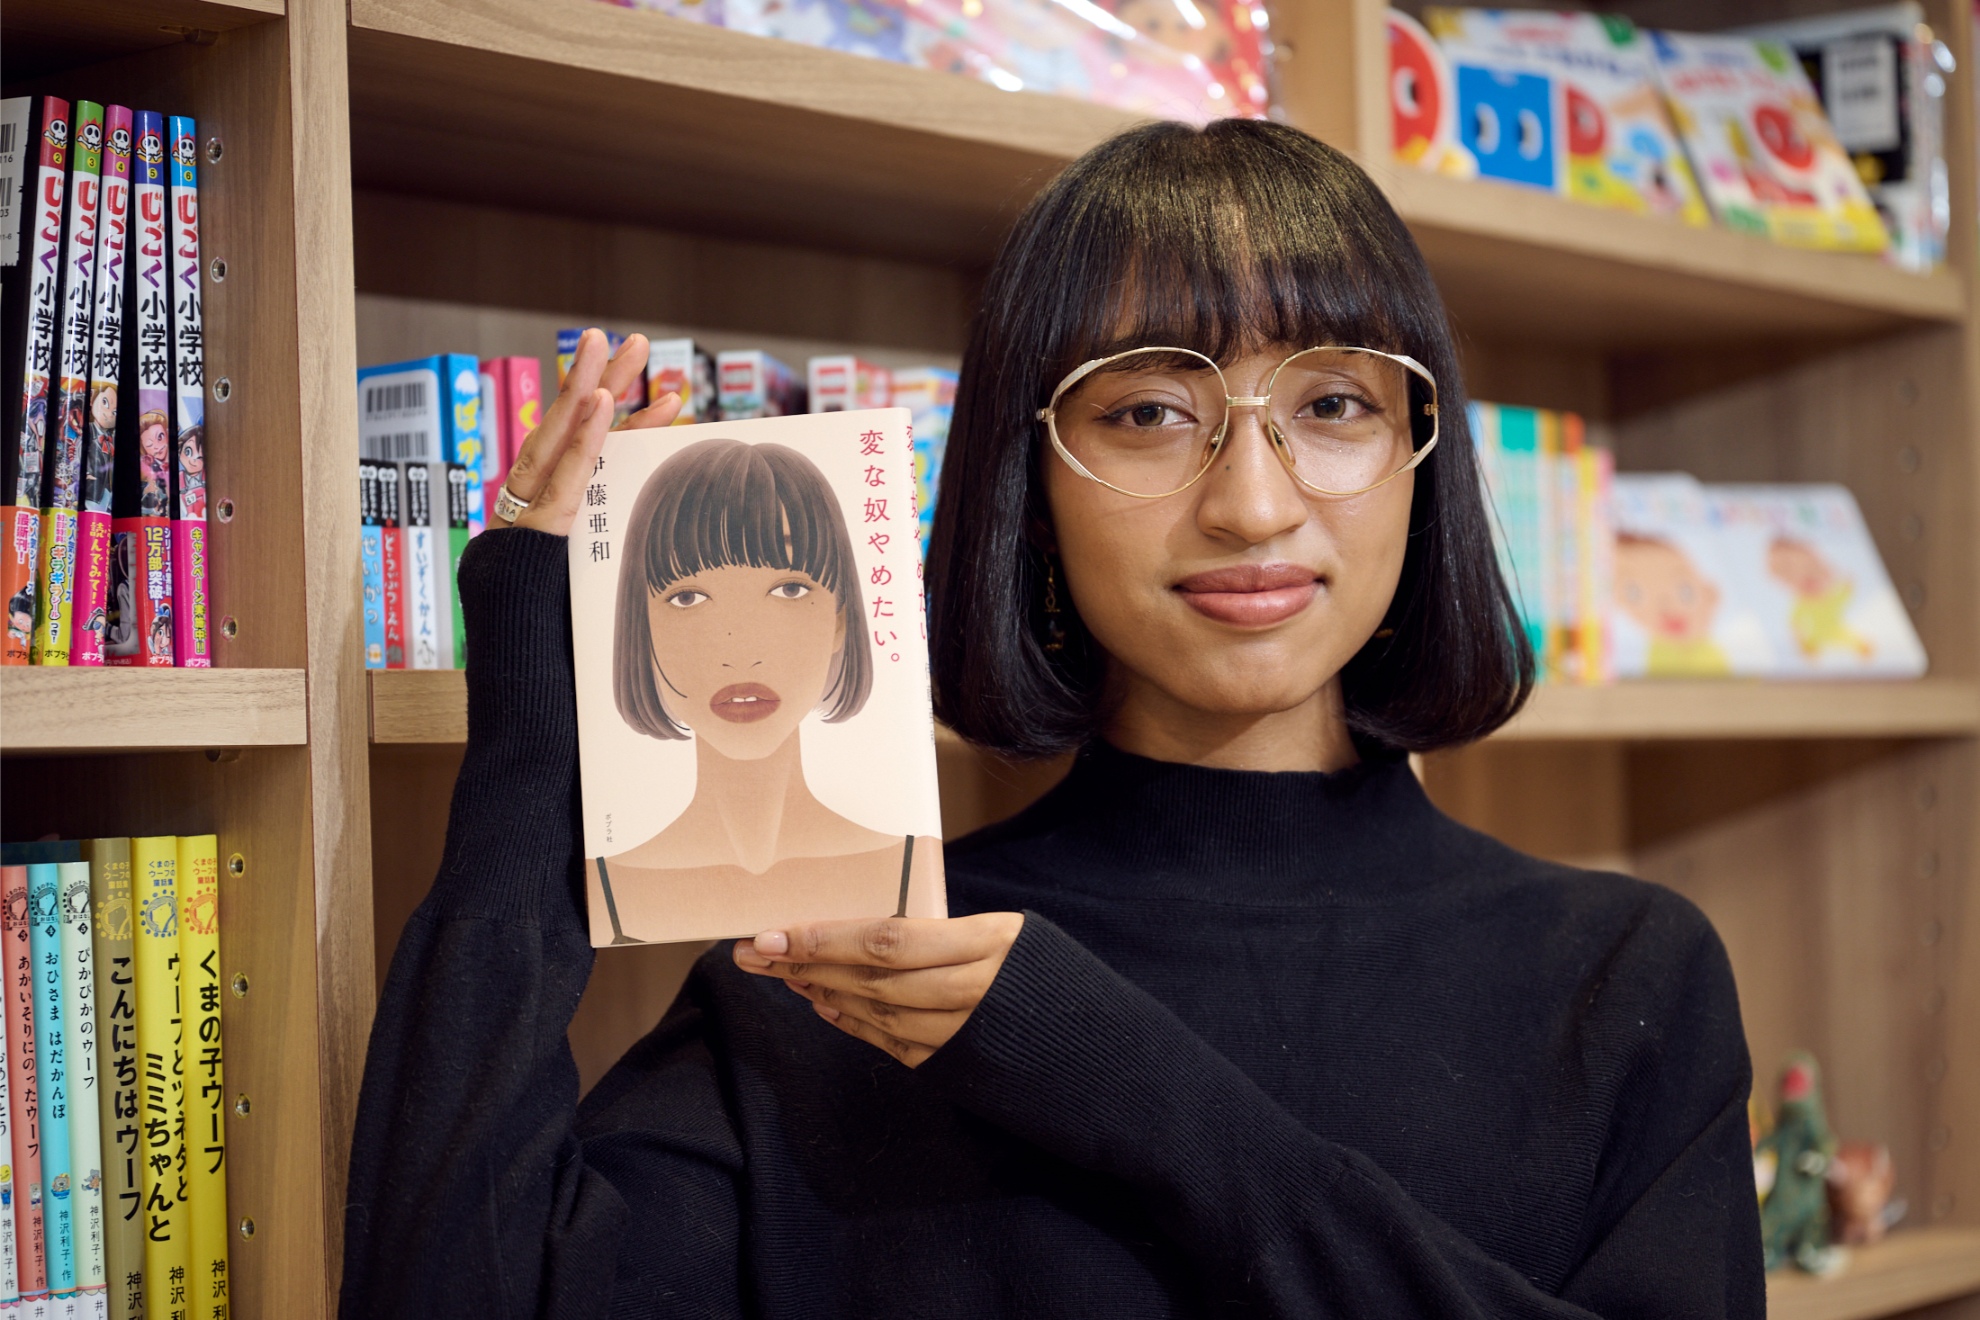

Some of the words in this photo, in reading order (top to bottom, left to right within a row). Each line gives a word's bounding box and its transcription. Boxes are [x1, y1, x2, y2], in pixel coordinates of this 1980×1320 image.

[94, 185, 128, 380] じごく小学校
[140, 191, 166, 387] じごく小学校
[177, 193, 203, 387] じごく小学校
[88, 522, 104, 605] 読んでみて!
[145, 526, 164, 613] 12万部突破!
[859, 429, 900, 663] 変な奴やめたい。
[6, 650, 29, 659] ポプラ
[110, 956, 142, 1221] こんにちはウーフ
[145, 1052, 173, 1242] ミミちゃんと
[199, 949, 225, 1174] くまの子ウーフ
[65, 1304, 74, 1320] 井
[126, 1271, 143, 1320] 神沢
